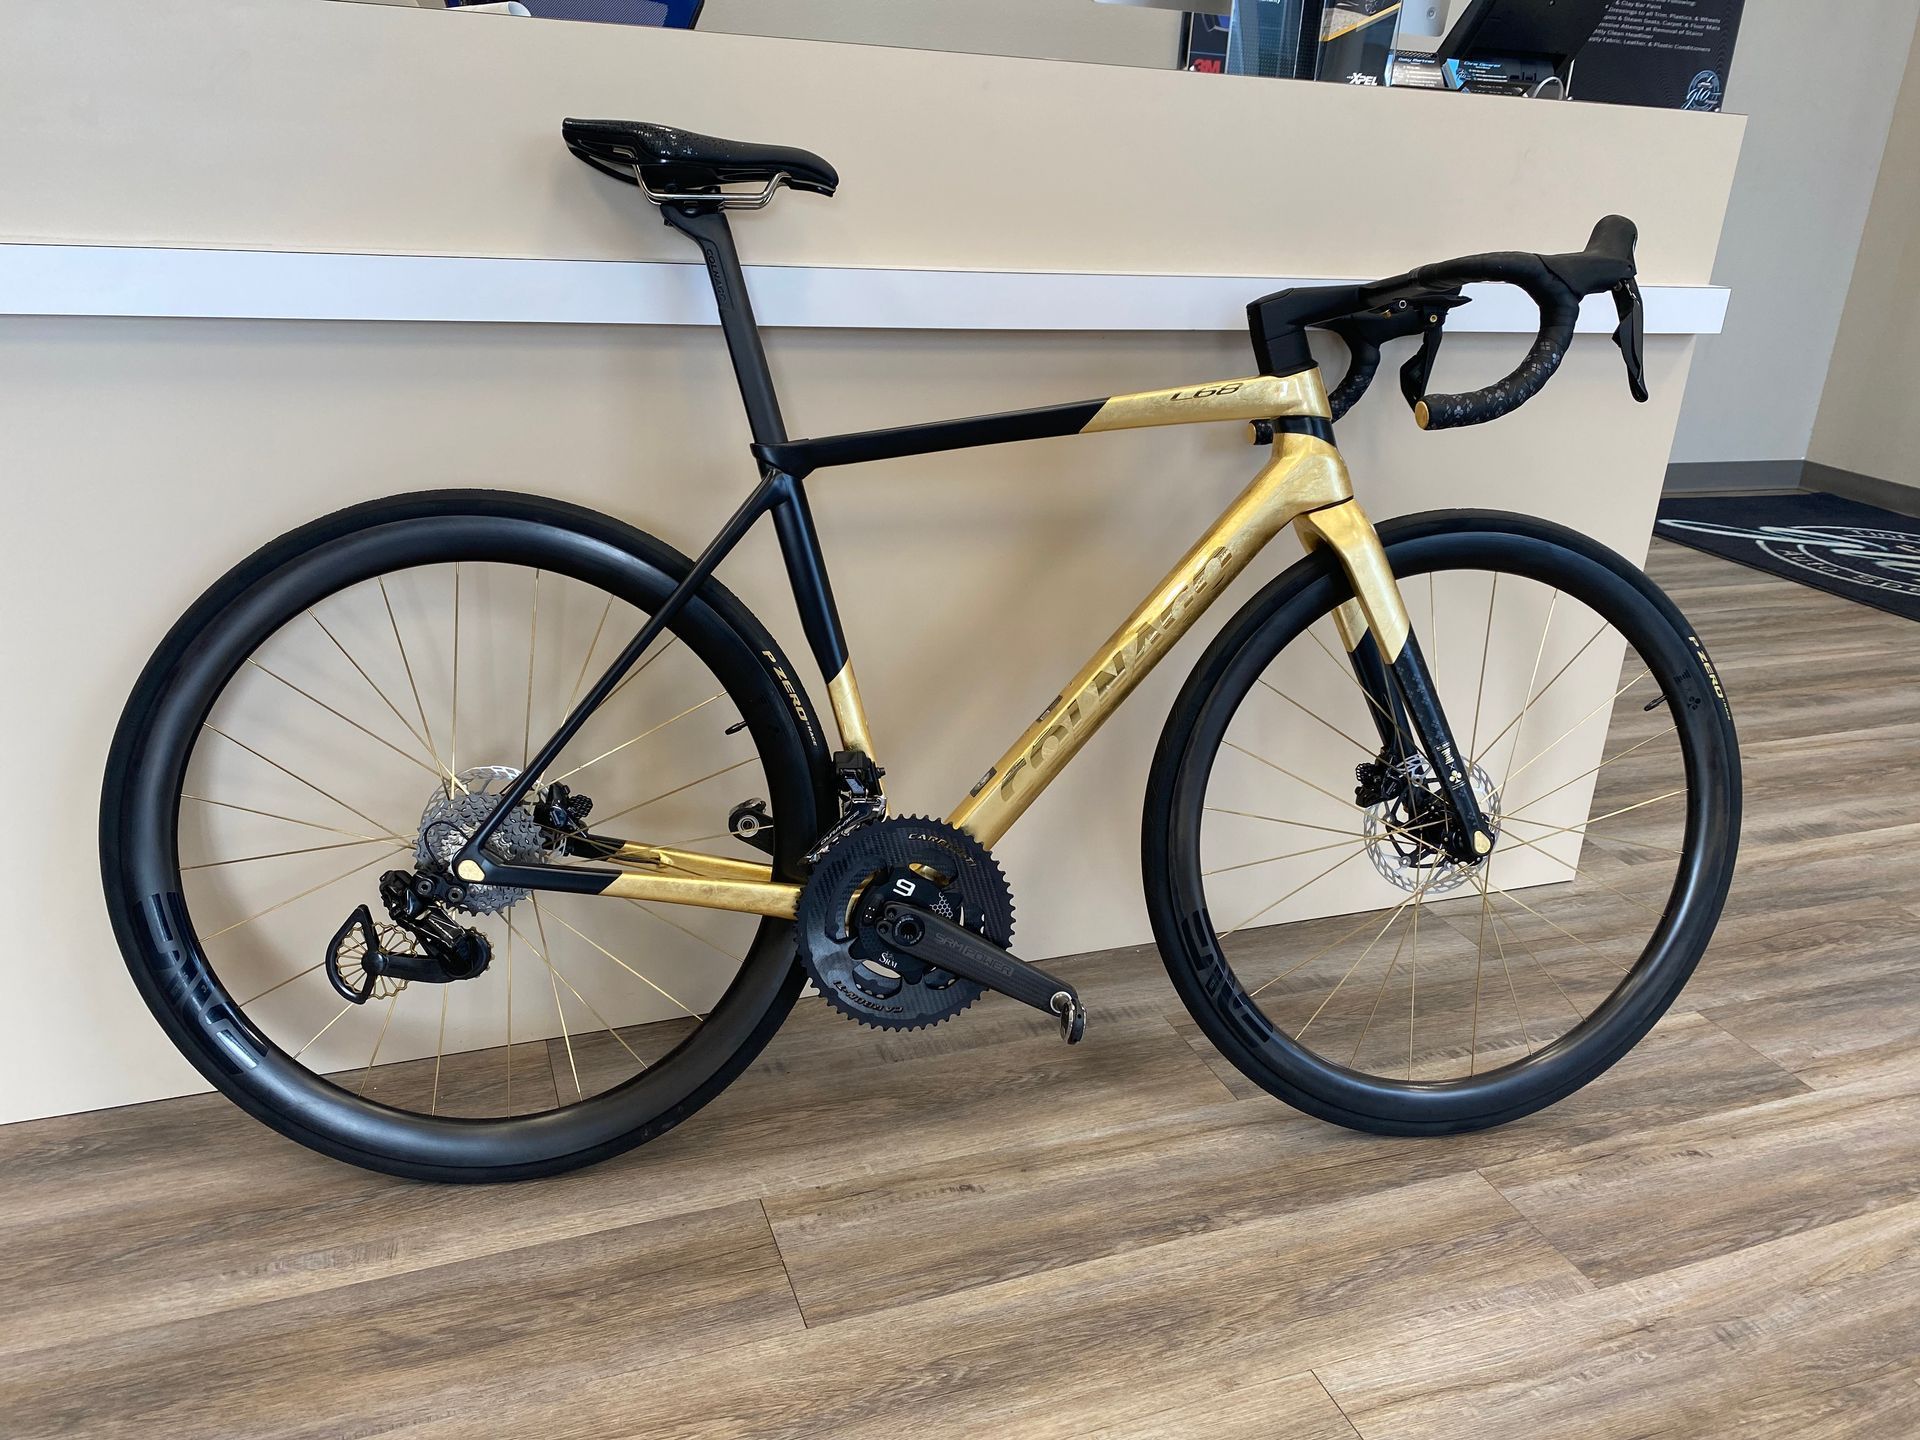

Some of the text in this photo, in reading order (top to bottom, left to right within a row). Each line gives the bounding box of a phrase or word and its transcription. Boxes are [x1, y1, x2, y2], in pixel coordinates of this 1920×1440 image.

[1608, 6, 1638, 15] Dressings
[1652, 26, 1678, 34] Removal
[1653, 41, 1673, 49] Plastic
[1674, 44, 1711, 52] Conditioners
[1194, 58, 1221, 73] 3M
[1349, 72, 1378, 86] XPEL
[706, 248, 727, 304] COLNAGO
[1000, 546, 1232, 802] COLNAGO
[1697, 650, 1724, 699] ZERO
[762, 650, 777, 663] P
[773, 666, 808, 721] ZERO
[893, 879, 916, 897] 9
